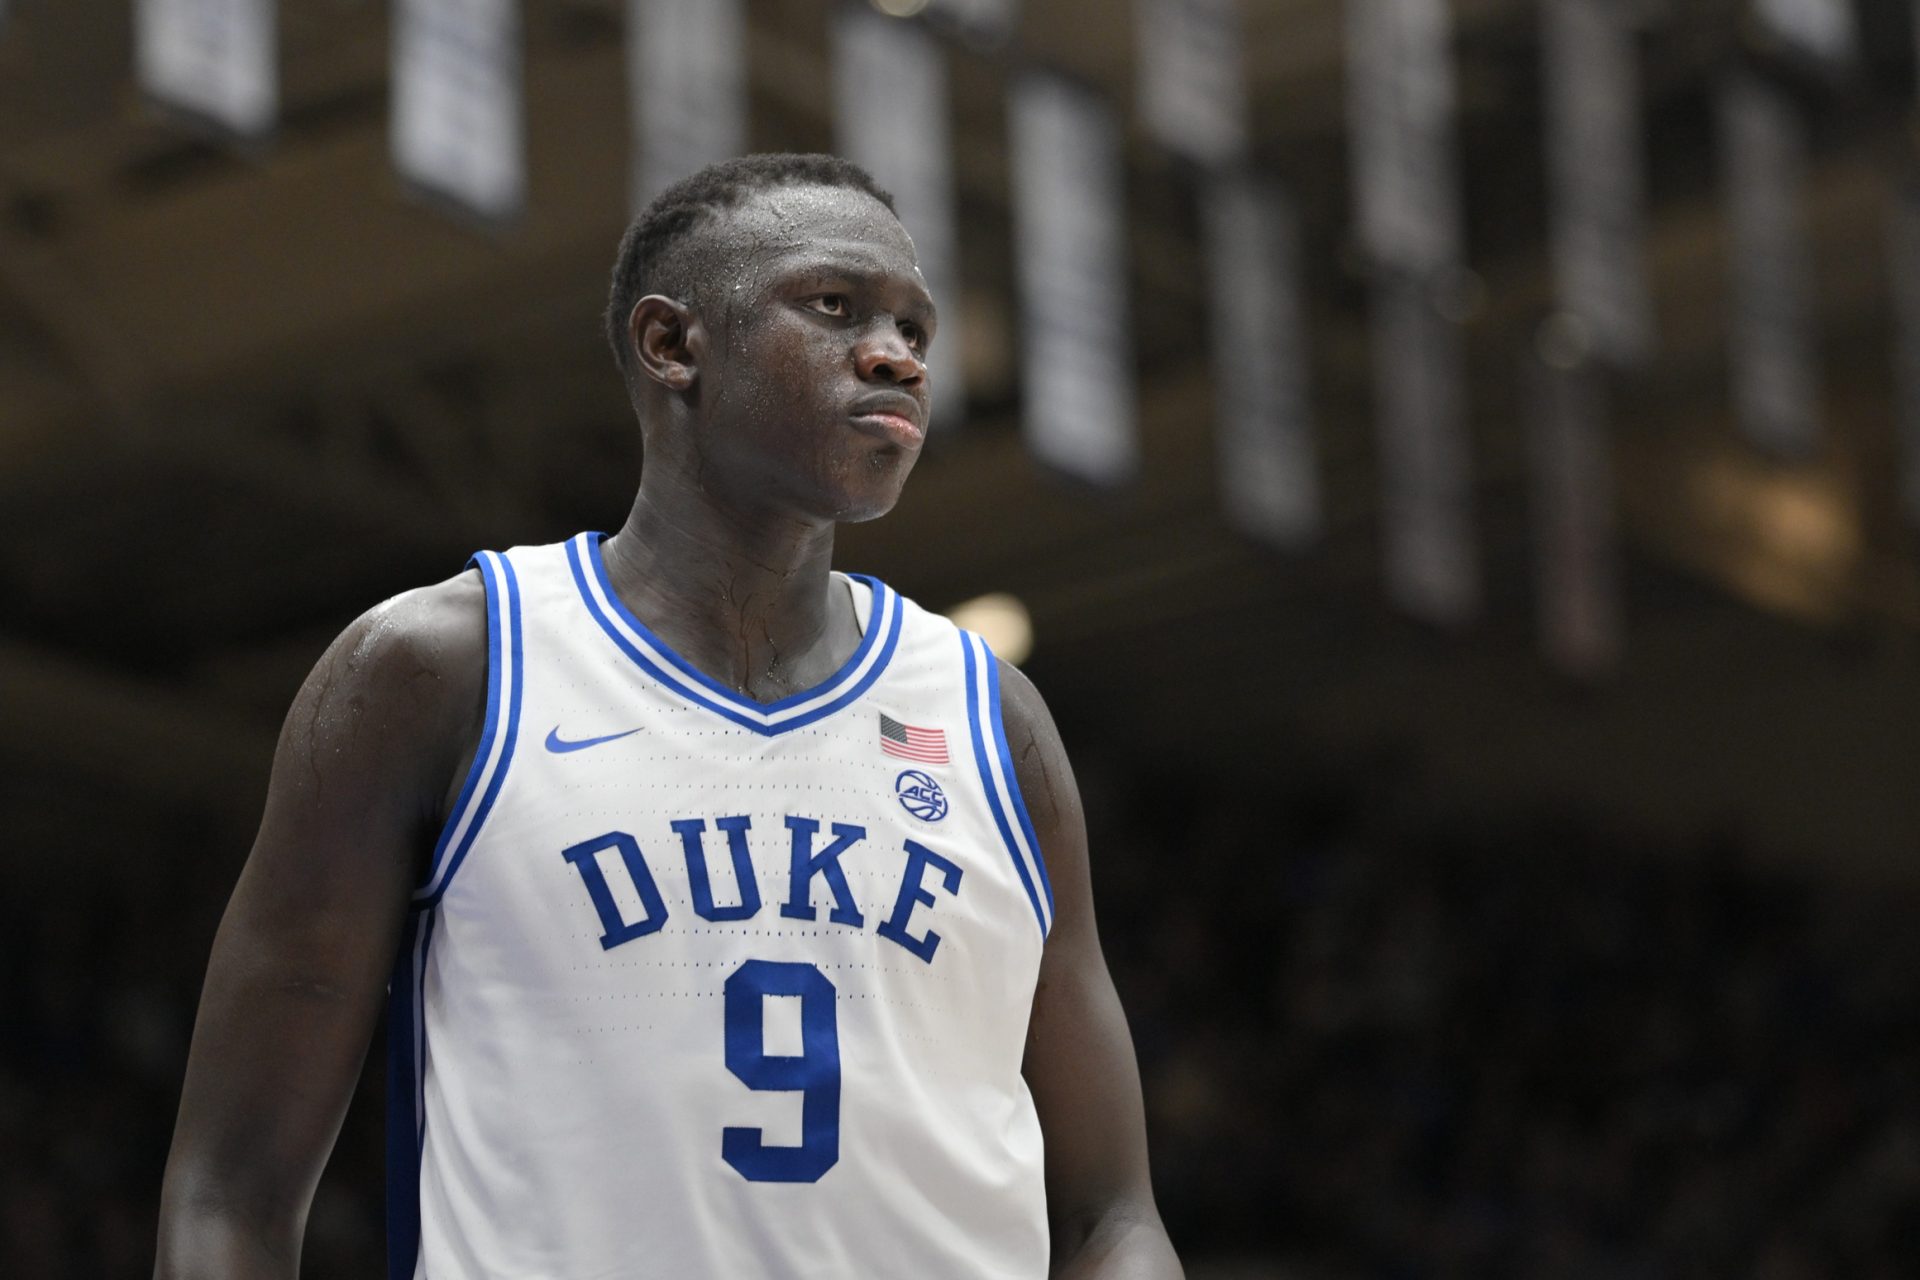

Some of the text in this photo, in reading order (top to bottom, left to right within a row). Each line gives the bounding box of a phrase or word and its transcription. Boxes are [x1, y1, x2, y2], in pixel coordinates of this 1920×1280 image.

[902, 786, 943, 807] ACC
[561, 815, 963, 964] DUKE
[722, 959, 841, 1183] 9
